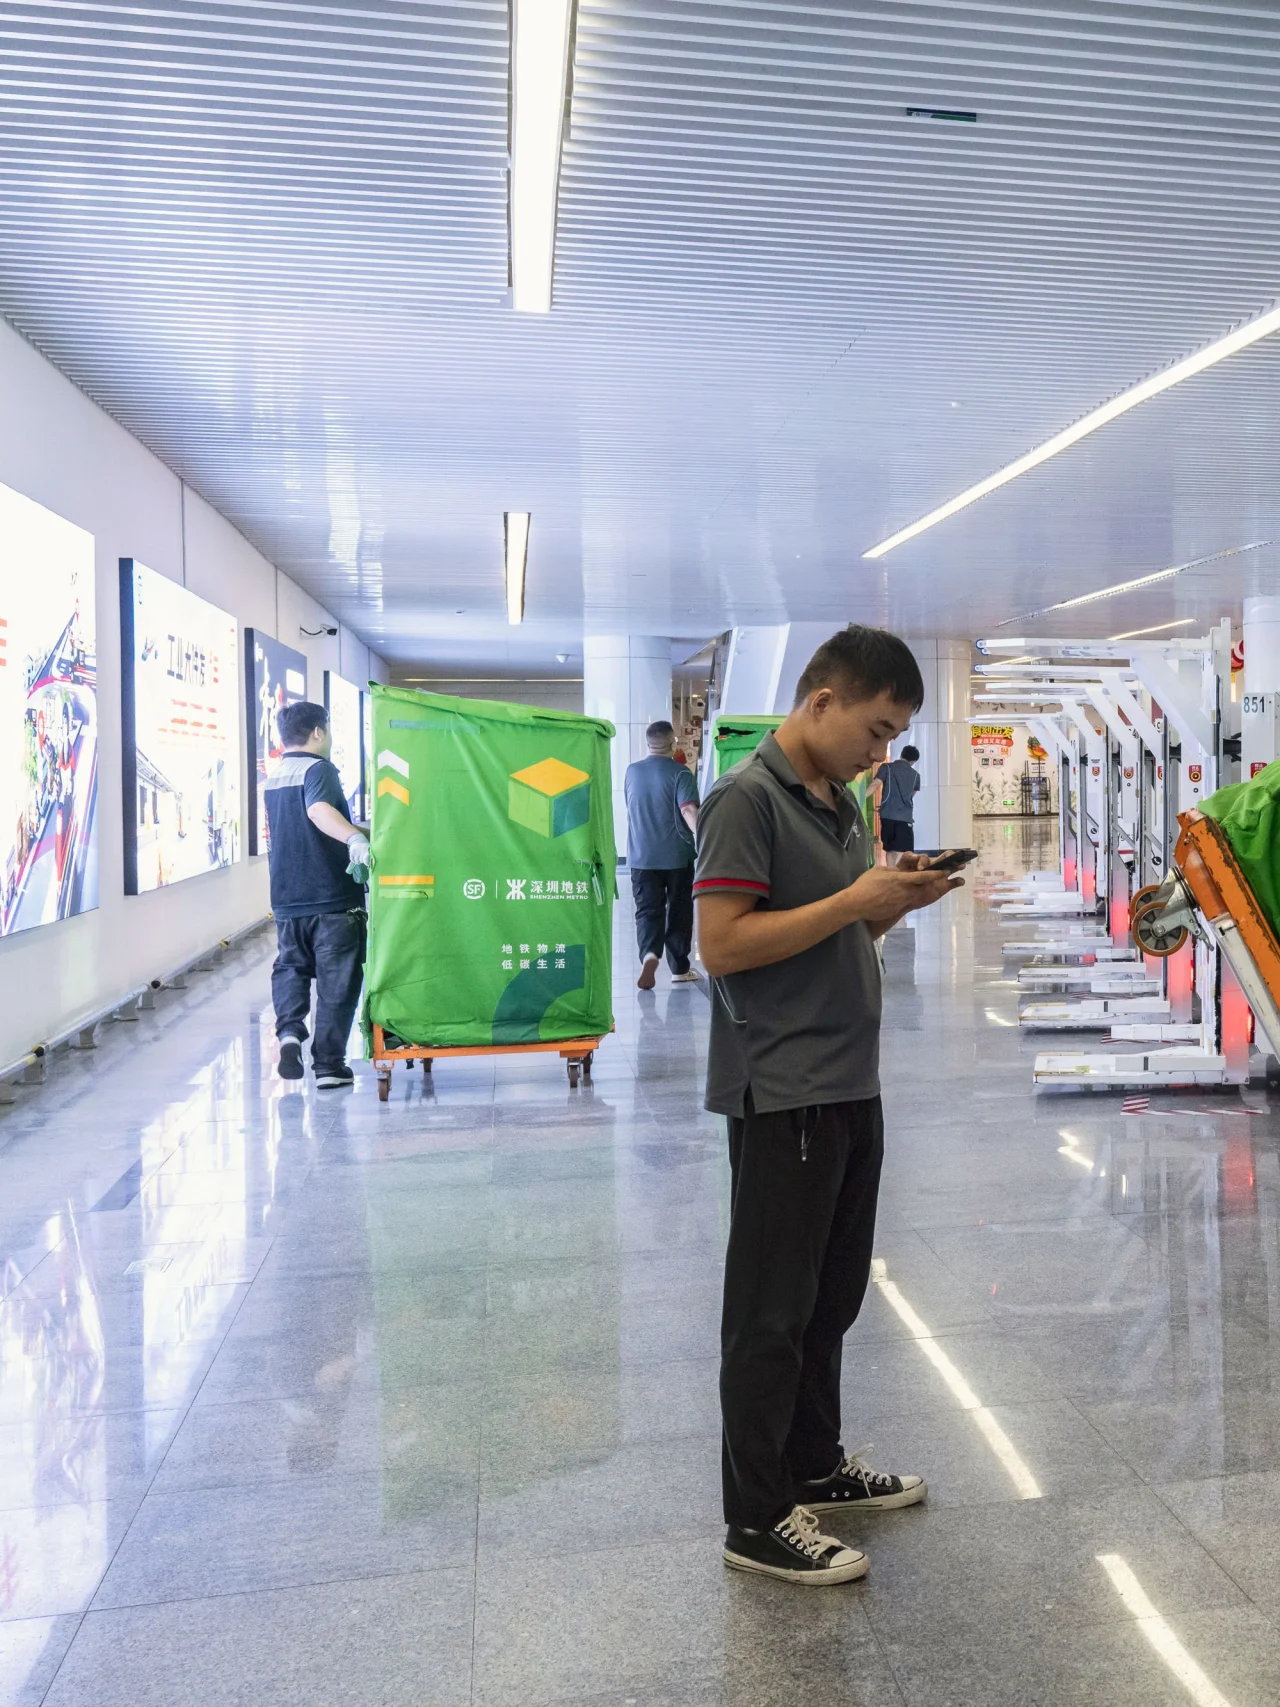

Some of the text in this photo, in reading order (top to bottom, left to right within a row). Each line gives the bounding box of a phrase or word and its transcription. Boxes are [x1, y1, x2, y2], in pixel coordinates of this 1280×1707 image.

[1243, 696, 1265, 714] 851
[530, 880, 589, 894] 深圳地铁
[501, 943, 566, 954] 地铁物流
[501, 958, 566, 970] 低碳生活
